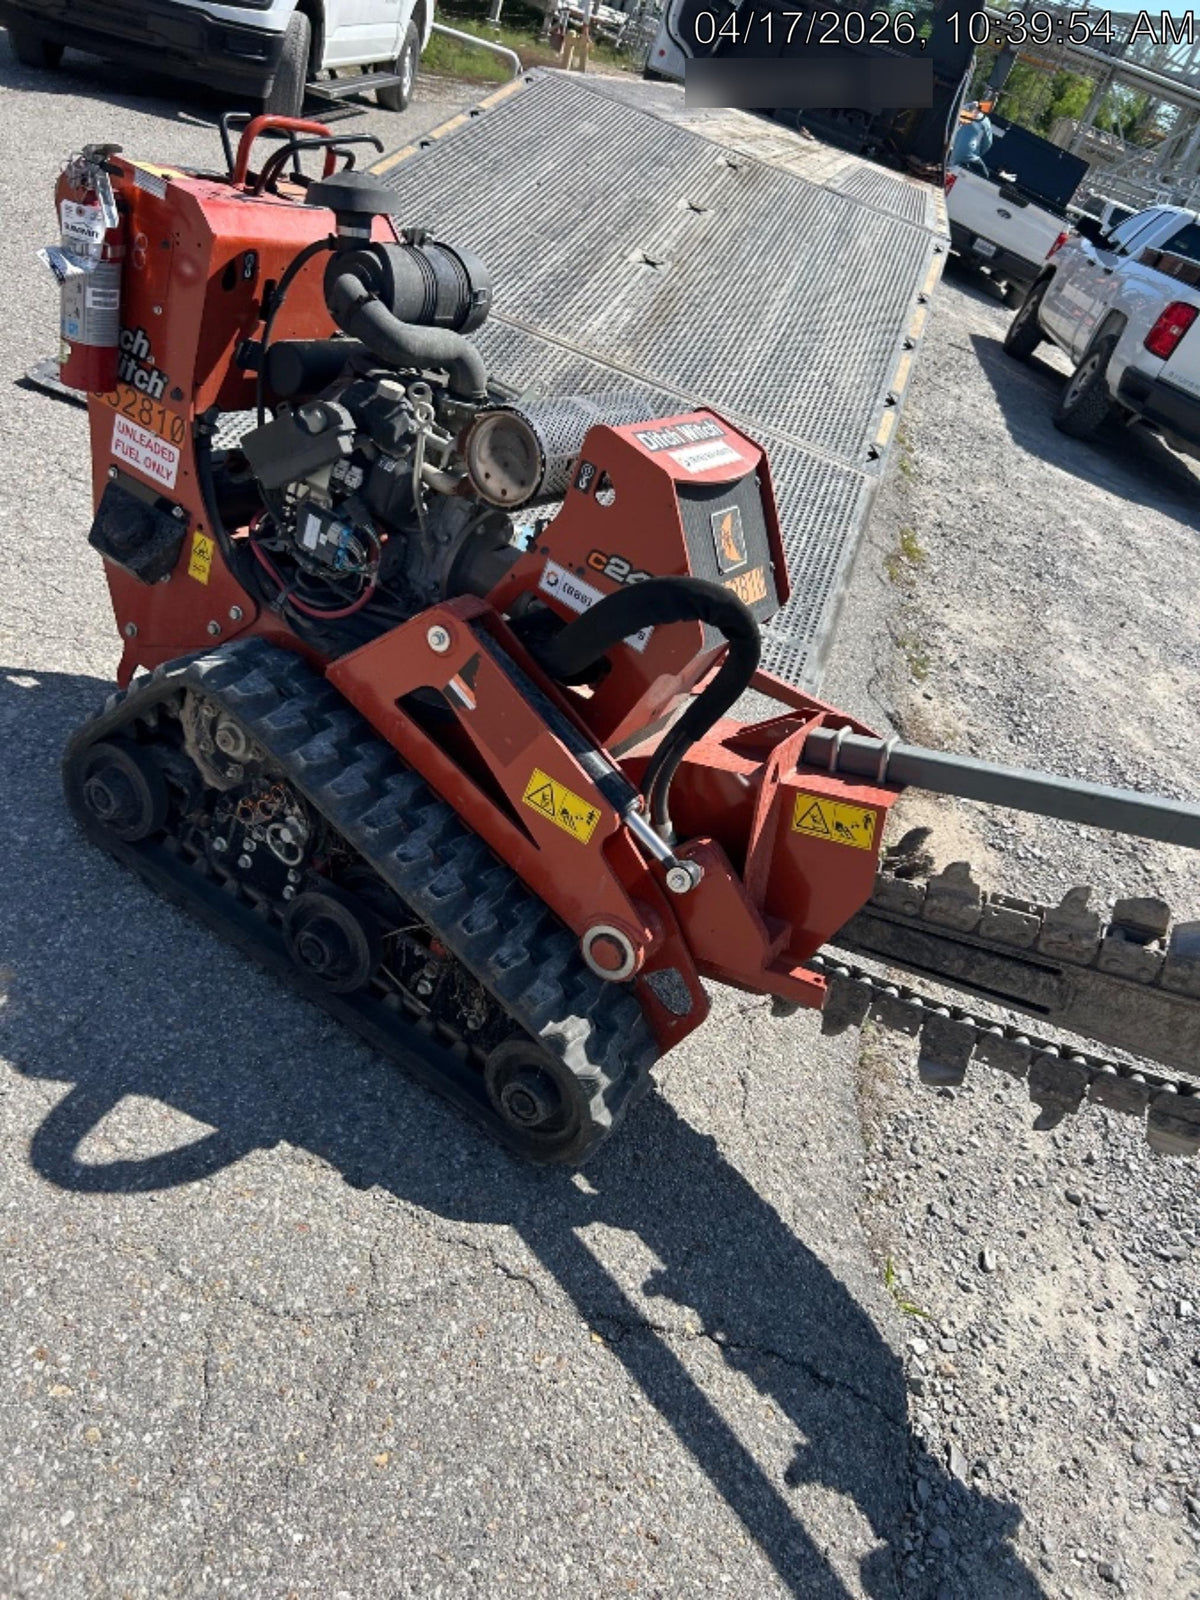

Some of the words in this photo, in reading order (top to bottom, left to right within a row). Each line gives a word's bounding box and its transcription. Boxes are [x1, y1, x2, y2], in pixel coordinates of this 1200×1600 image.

[119, 352, 165, 399] itch
[117, 420, 176, 463] UNLEADED
[634, 427, 687, 451] Ditch
[675, 419, 725, 441] Witch
[114, 438, 141, 466] FUEL
[143, 455, 173, 481] ONLY
